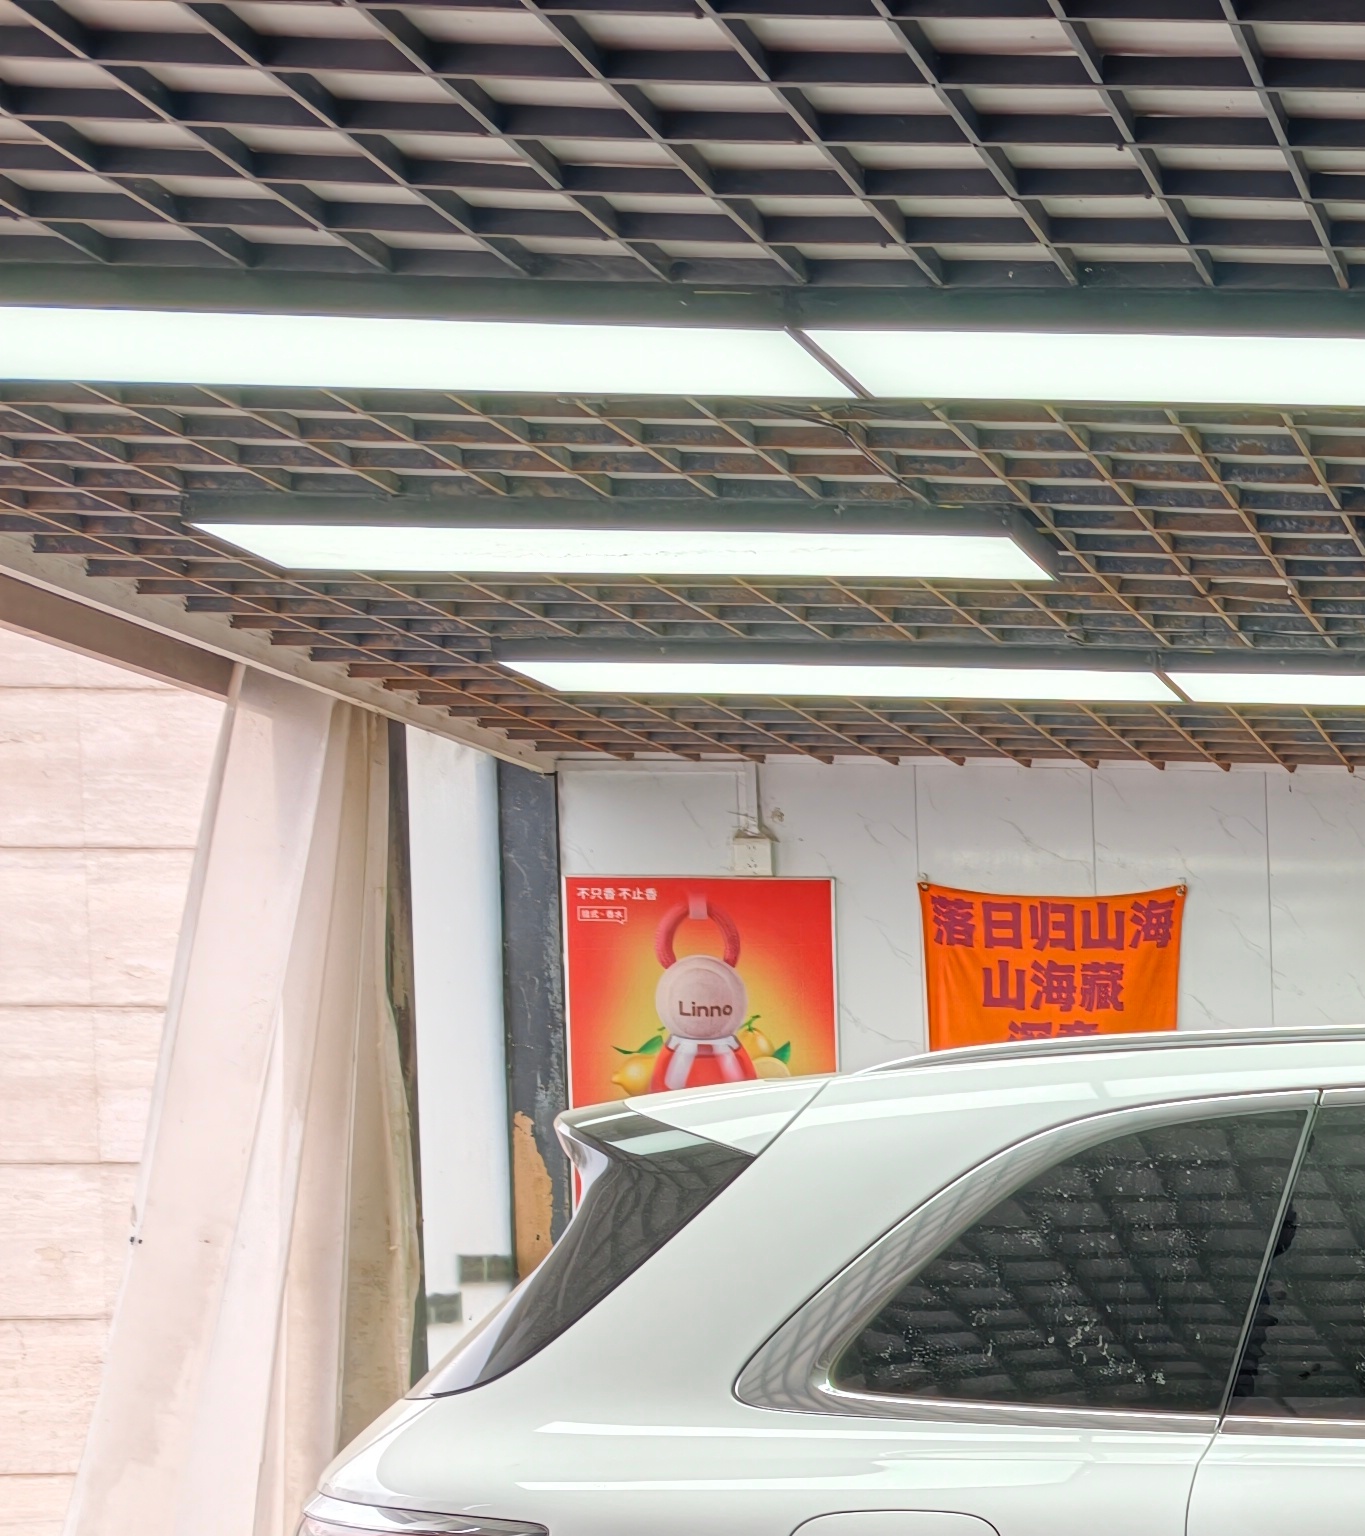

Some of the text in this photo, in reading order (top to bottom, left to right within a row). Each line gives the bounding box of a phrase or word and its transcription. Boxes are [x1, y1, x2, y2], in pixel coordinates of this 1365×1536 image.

[930, 894, 1176, 951] 落日归山海
[679, 1000, 733, 1017] Linno
[982, 959, 1125, 1012] 山海藏
